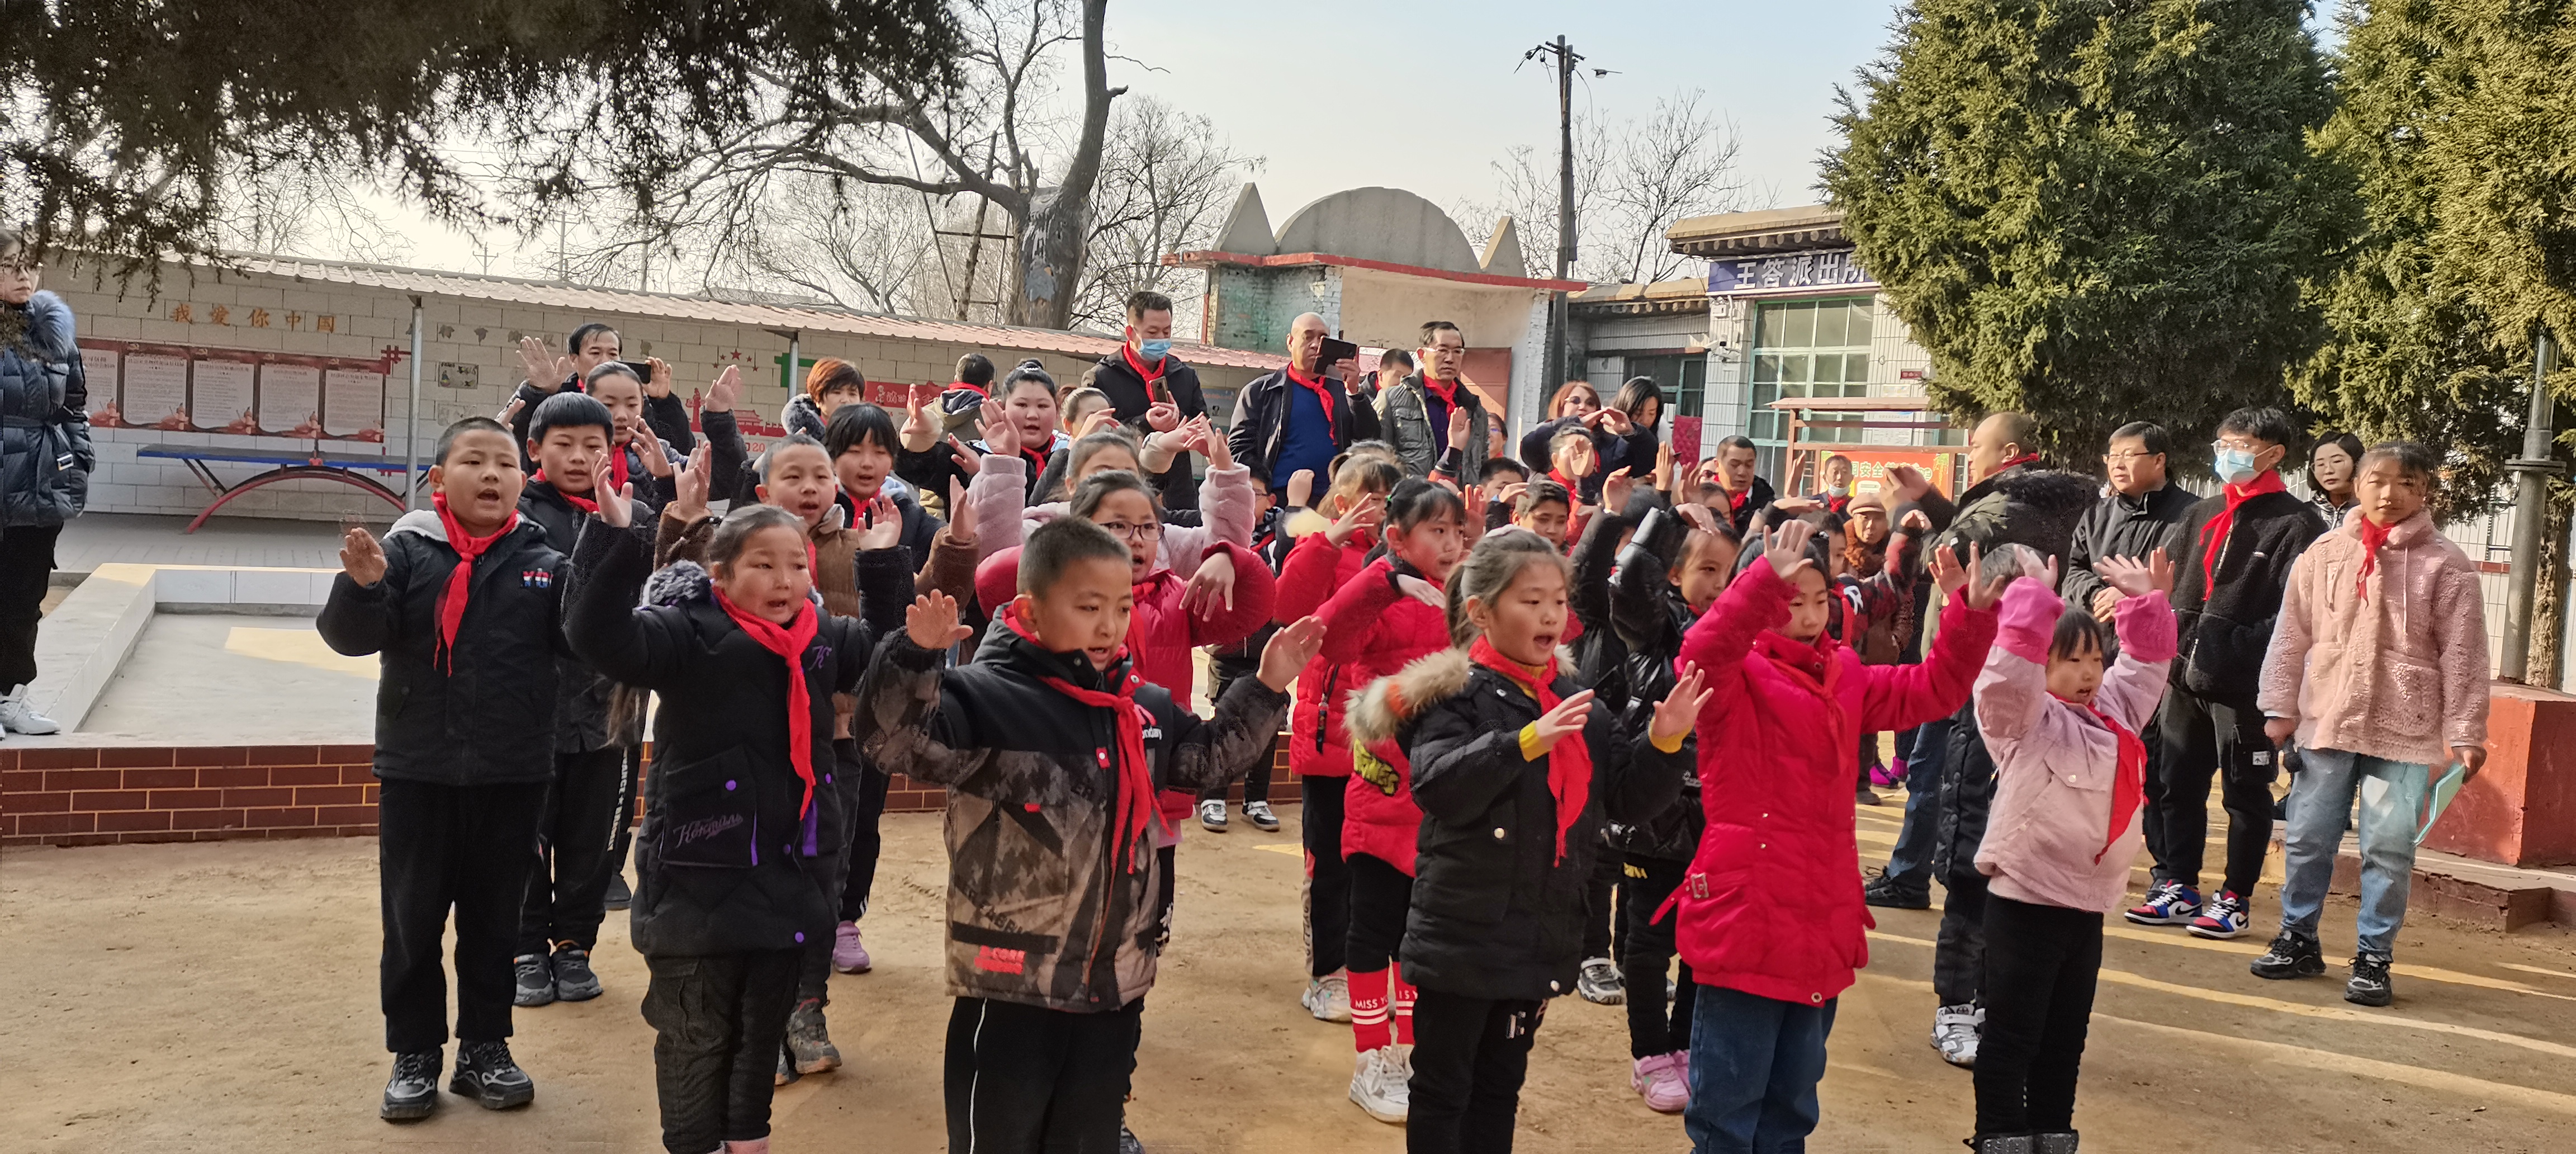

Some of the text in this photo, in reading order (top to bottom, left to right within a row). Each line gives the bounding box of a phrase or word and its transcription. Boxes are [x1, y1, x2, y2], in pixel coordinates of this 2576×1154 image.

[169, 304, 335, 334] 我爱你中国
[1843, 585, 1864, 616] R
[1355, 998, 1378, 1009] MISS
